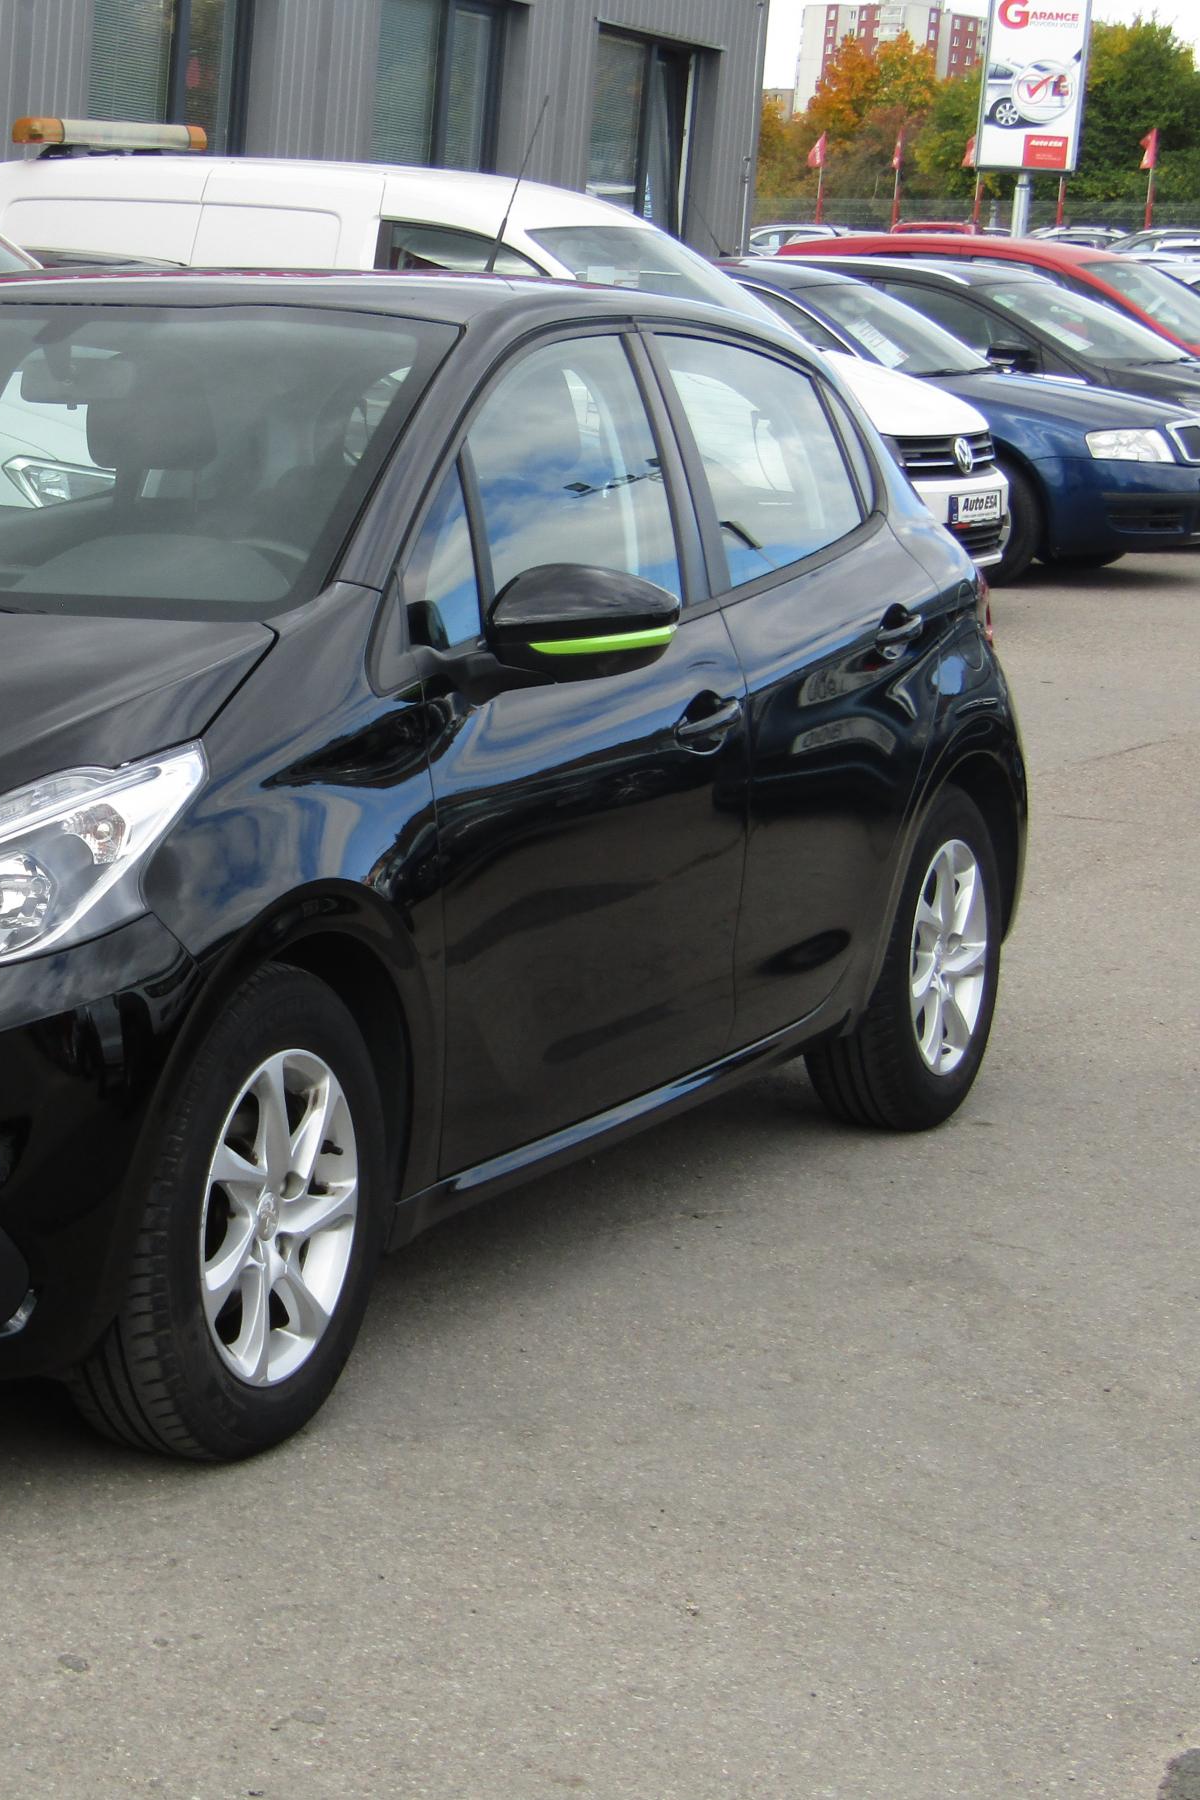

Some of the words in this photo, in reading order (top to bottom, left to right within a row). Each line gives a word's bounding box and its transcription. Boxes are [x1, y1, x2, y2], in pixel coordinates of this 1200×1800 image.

[998, 0, 1079, 29] GARANCE
[962, 496, 984, 512] Auto
[984, 494, 997, 510] ESA
